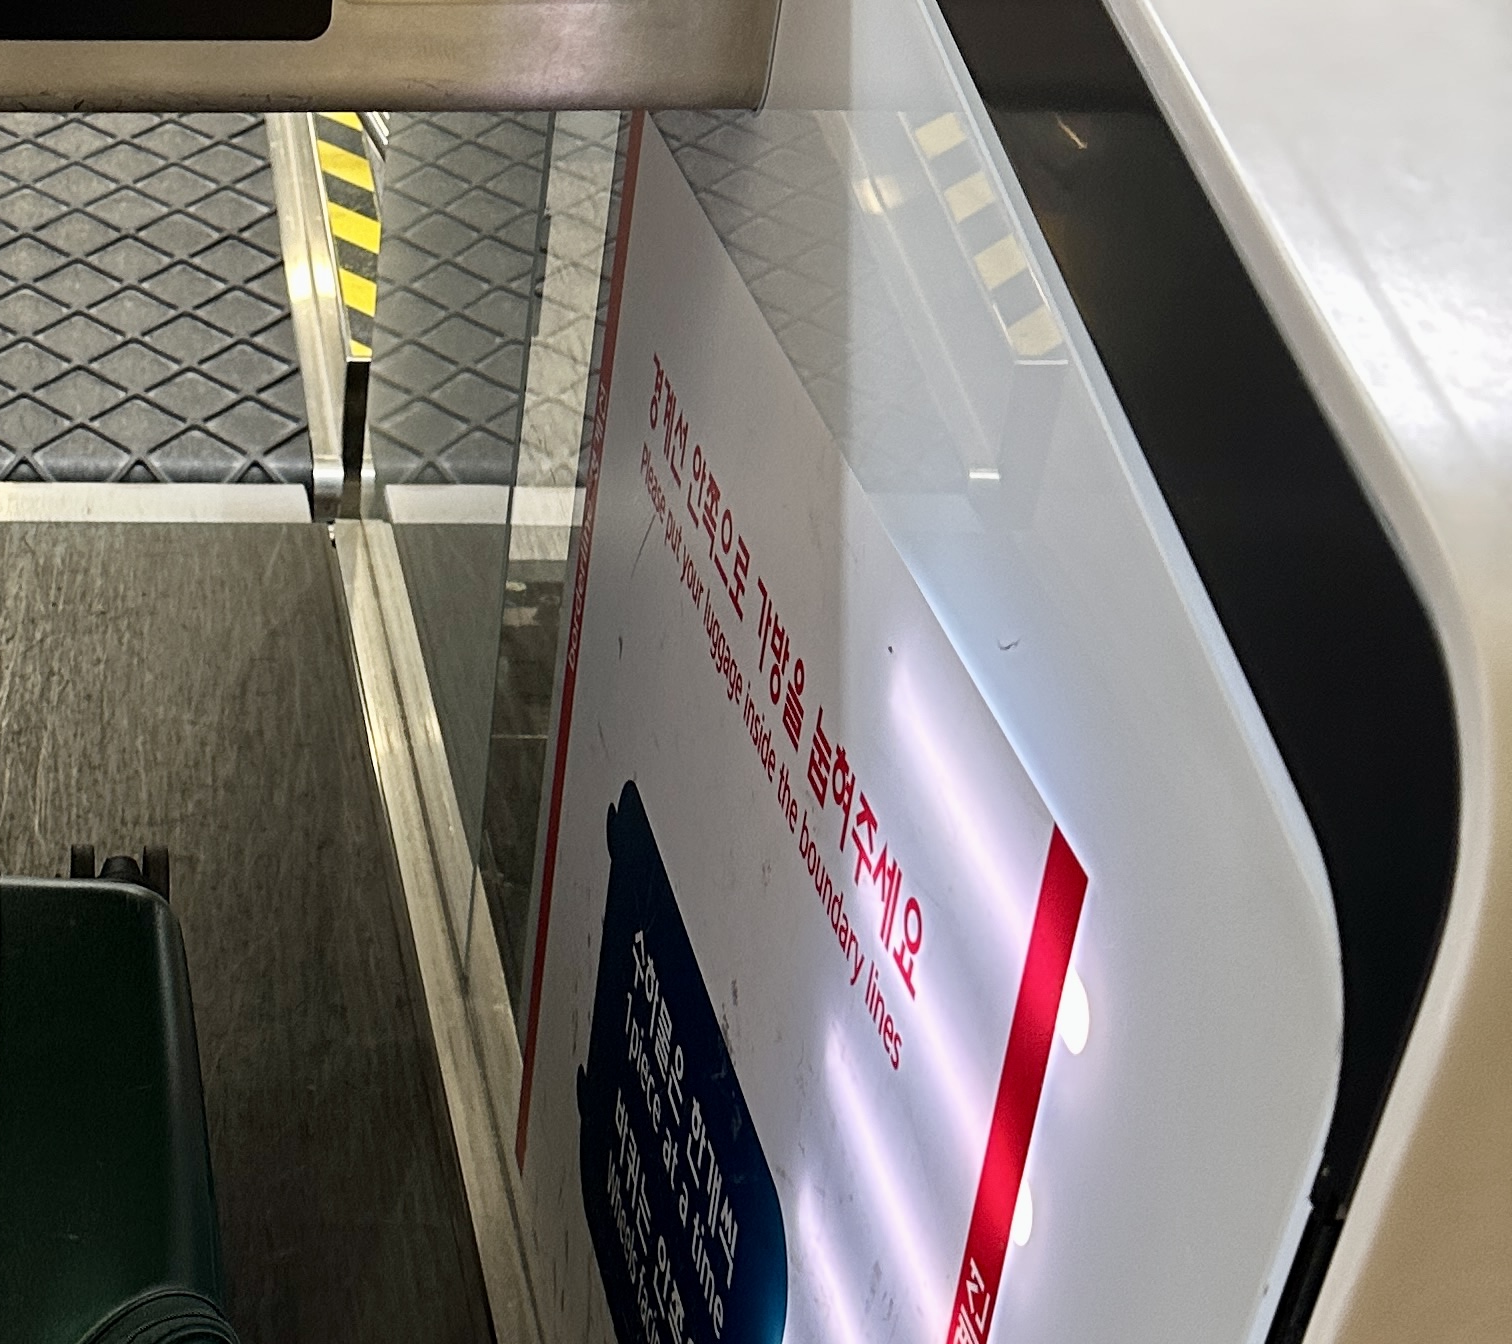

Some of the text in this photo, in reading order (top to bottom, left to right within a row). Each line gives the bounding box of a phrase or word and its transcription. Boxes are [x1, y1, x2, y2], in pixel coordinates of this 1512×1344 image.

[640, 441, 903, 1071] Please put your luggage inside the boundary lines
[649, 351, 923, 1001] 경계선 안쪽으로 가방을 눕혀주세요
[607, 1149, 638, 1284] Wheels
[615, 1087, 651, 1256] 바퀴는
[632, 929, 737, 1290] 수하물은 한개씩
[662, 1127, 678, 1191] at
[678, 1181, 688, 1229] a
[692, 1212, 724, 1340] time
